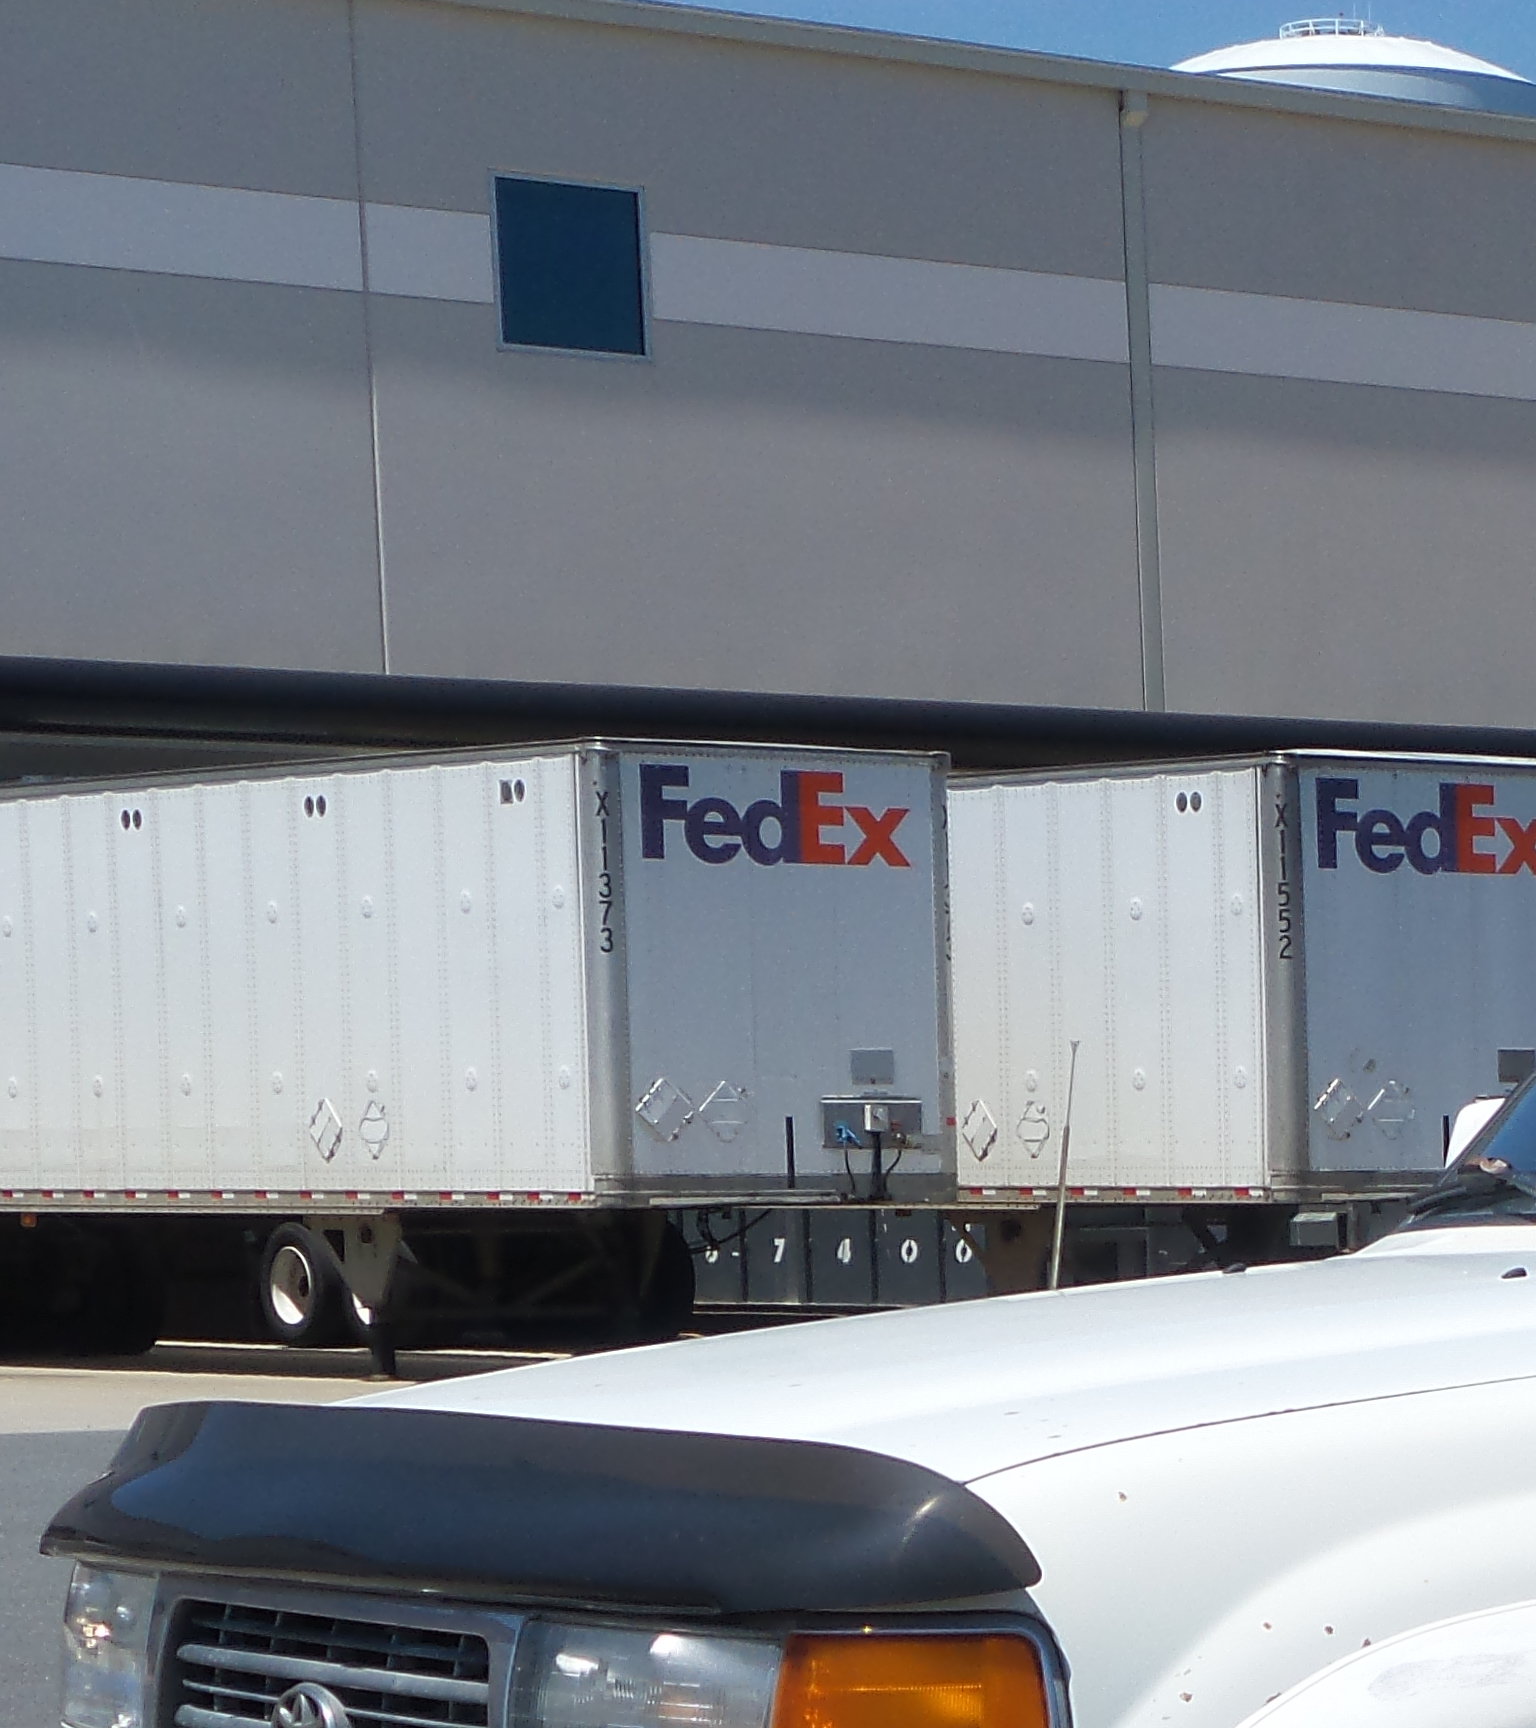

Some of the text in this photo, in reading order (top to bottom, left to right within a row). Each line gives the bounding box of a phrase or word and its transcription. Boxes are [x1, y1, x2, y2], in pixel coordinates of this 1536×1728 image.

[595, 790, 615, 953] X11373
[639, 763, 911, 868] FedEx
[1275, 803, 1293, 959] X11552
